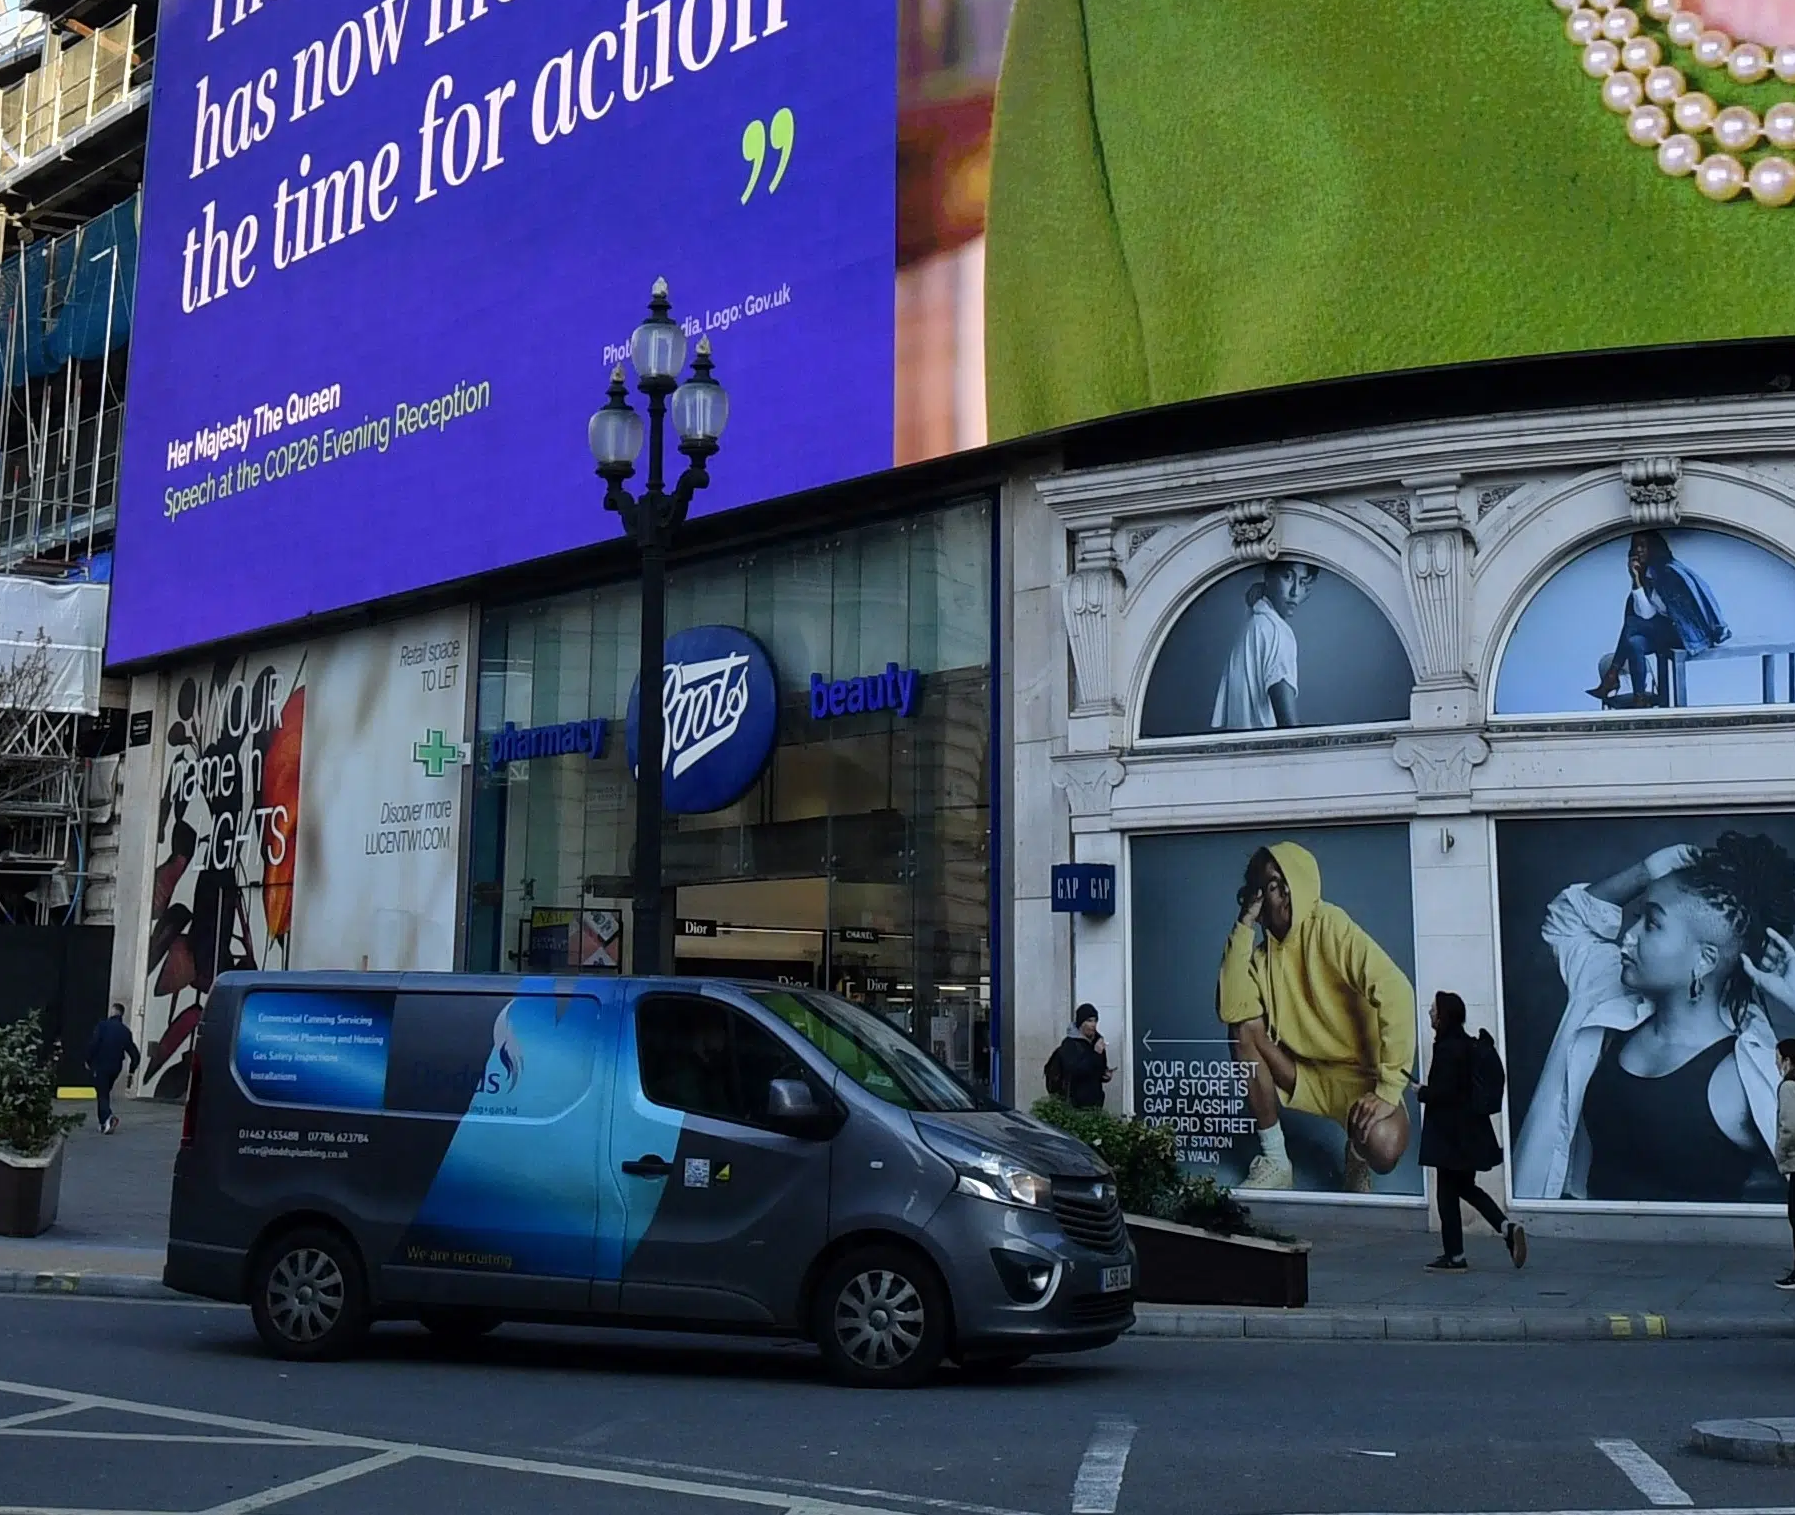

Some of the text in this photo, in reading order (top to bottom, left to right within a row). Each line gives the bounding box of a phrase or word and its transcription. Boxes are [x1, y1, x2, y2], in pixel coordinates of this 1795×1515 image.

[188, 76, 277, 180] has
[180, 201, 257, 315] the
[272, 138, 399, 271] time
[414, 74, 517, 204] for
[705, 302, 742, 330] Logo:
[744, 282, 791, 317] Gov.uk
[167, 383, 341, 471] Her Majesty The Queen
[163, 379, 491, 523] Speech at the COP26 Evening Reception
[400, 640, 460, 666] Retail space
[421, 664, 459, 692] TO LET
[810, 662, 920, 720] beauty
[212, 673, 284, 739] YOUR
[489, 717, 606, 766] pharmacy
[168, 742, 263, 805] name in
[380, 799, 452, 826] Discover more
[193, 805, 289, 871] LIGHTS
[1057, 877, 1079, 899] GAP
[1090, 877, 1110, 899] GAP
[684, 920, 708, 935] Dior
[845, 930, 875, 940] CHANEL
[867, 978, 889, 992] Dior
[258, 1013, 302, 1024] Commercial
[337, 1014, 373, 1027] Servicing
[301, 1033, 336, 1046] Plumbing
[337, 1034, 353, 1044] and
[353, 1034, 384, 1046] Heating
[253, 1051, 267, 1061] Gas
[1143, 1061, 1259, 1078] YOUR CLOSEST
[1143, 1079, 1248, 1097] GAP STORE IS
[1143, 1098, 1244, 1114] GAP FLAGSHIP
[238, 1129, 265, 1140] 01462
[307, 1130, 335, 1142] 07786
[1204, 1118, 1257, 1134] STREET
[1190, 1136, 1233, 1148] STATION
[1187, 1150, 1220, 1165] WALK)
[407, 1245, 513, 1270] We are recruiting
